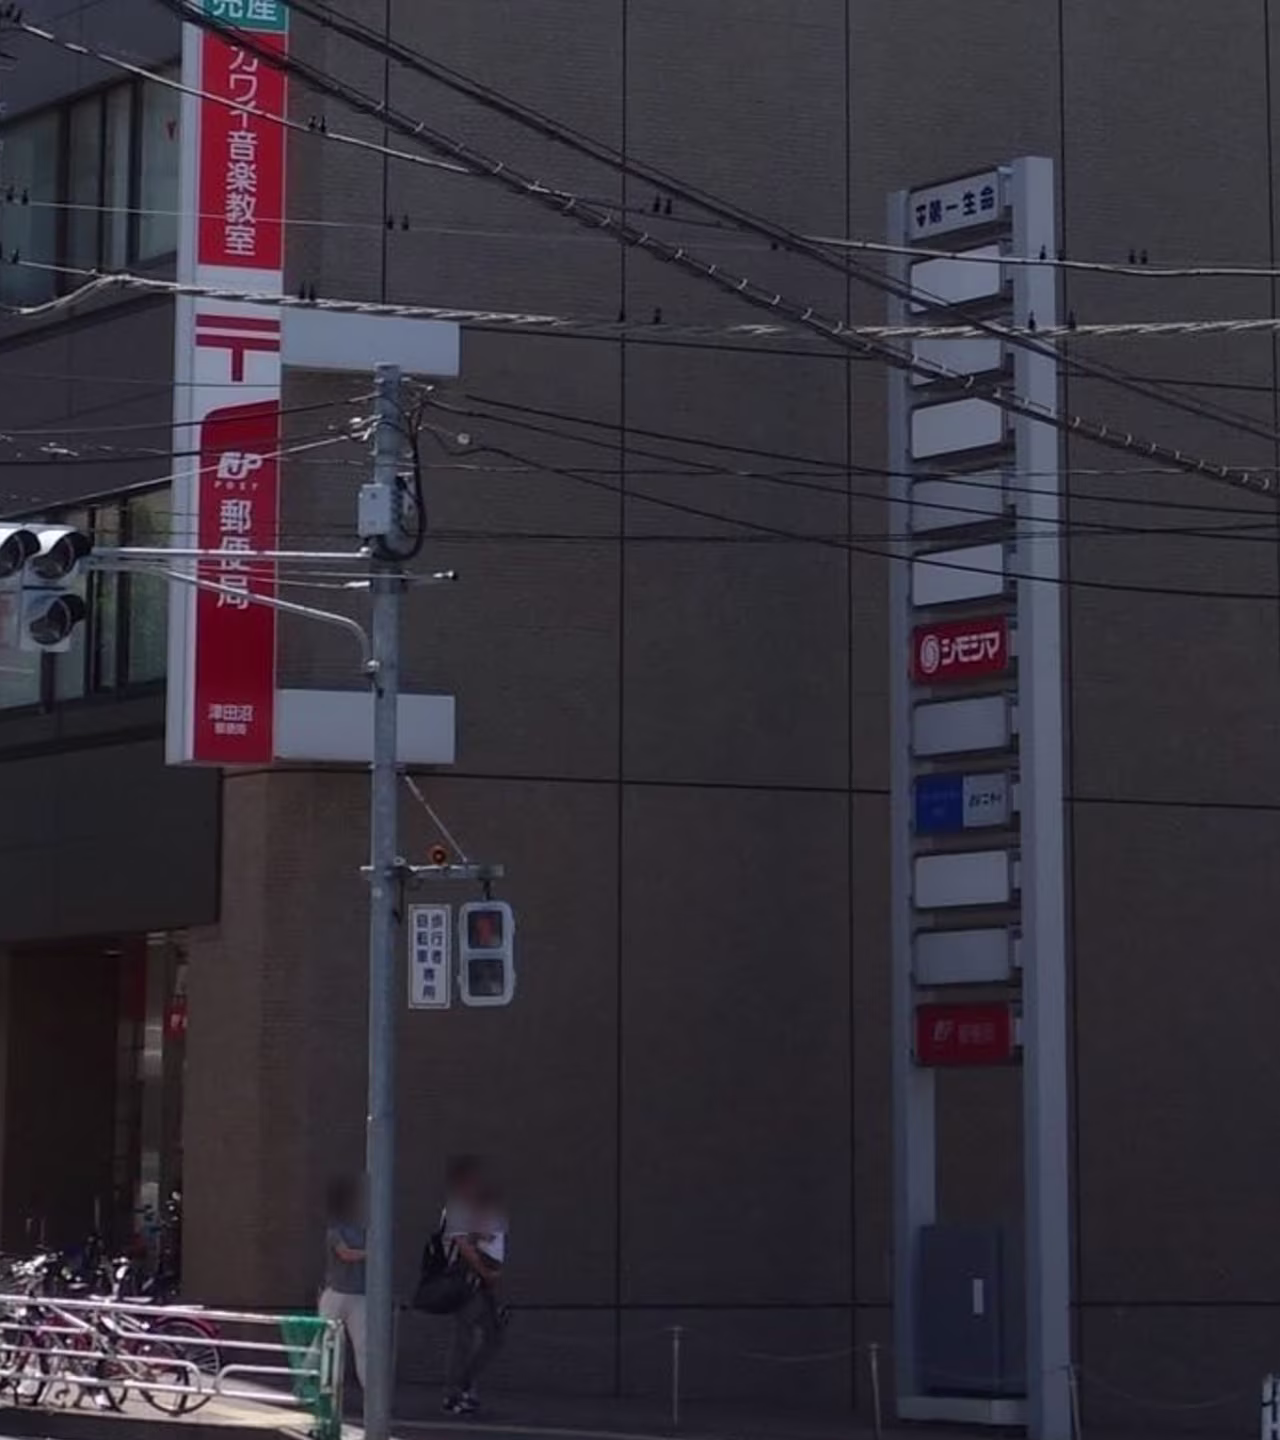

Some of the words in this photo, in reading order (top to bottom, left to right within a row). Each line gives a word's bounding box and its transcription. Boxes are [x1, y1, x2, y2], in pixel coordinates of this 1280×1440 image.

[224, 46, 258, 256] カワイ音楽教室
[928, 186, 994, 224] 第一生命
[217, 499, 251, 610] 郵便局
[942, 631, 1000, 666] シモジマ
